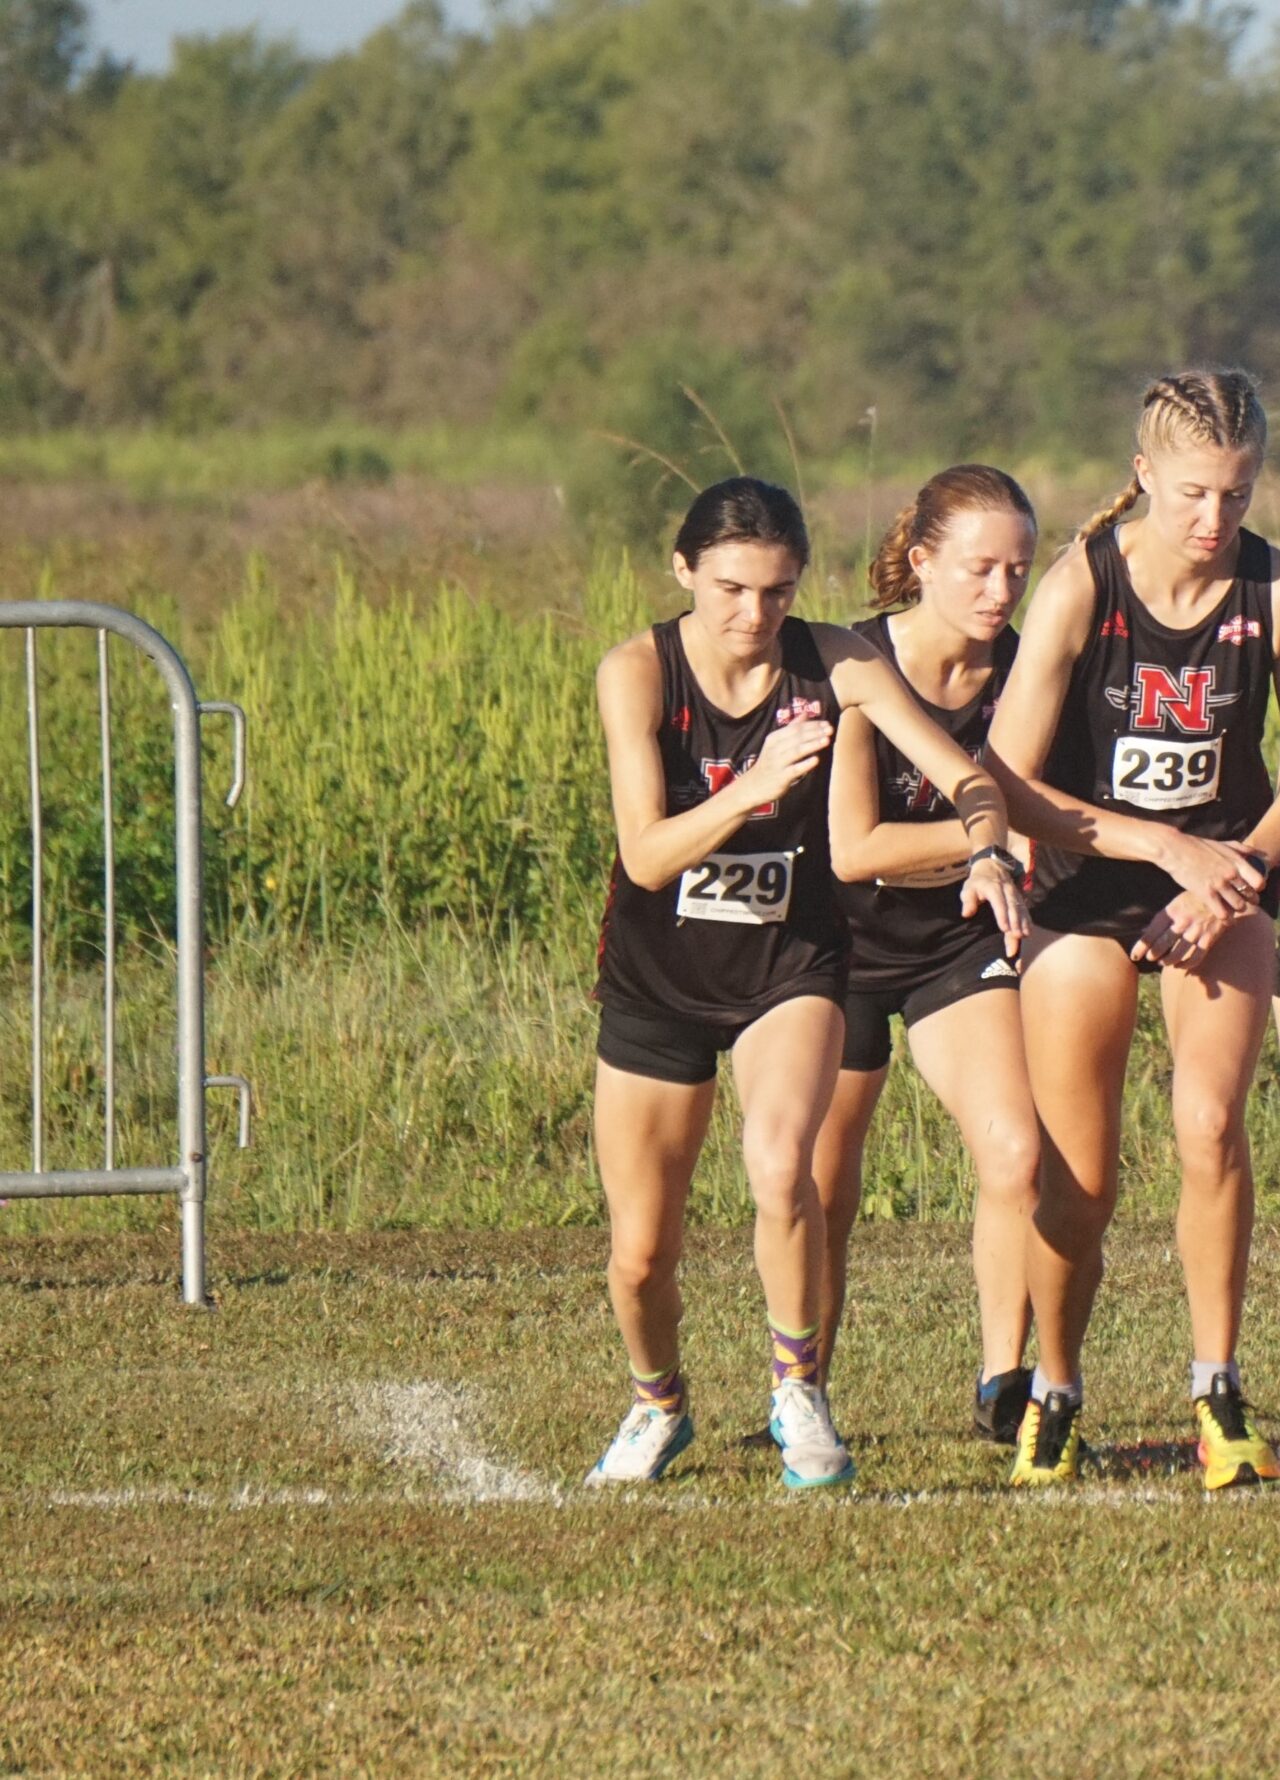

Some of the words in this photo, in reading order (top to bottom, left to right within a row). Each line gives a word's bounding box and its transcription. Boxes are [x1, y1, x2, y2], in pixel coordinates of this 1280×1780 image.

[1130, 662, 1216, 733] N
[1119, 748, 1217, 791] 239
[687, 861, 787, 906] 229
